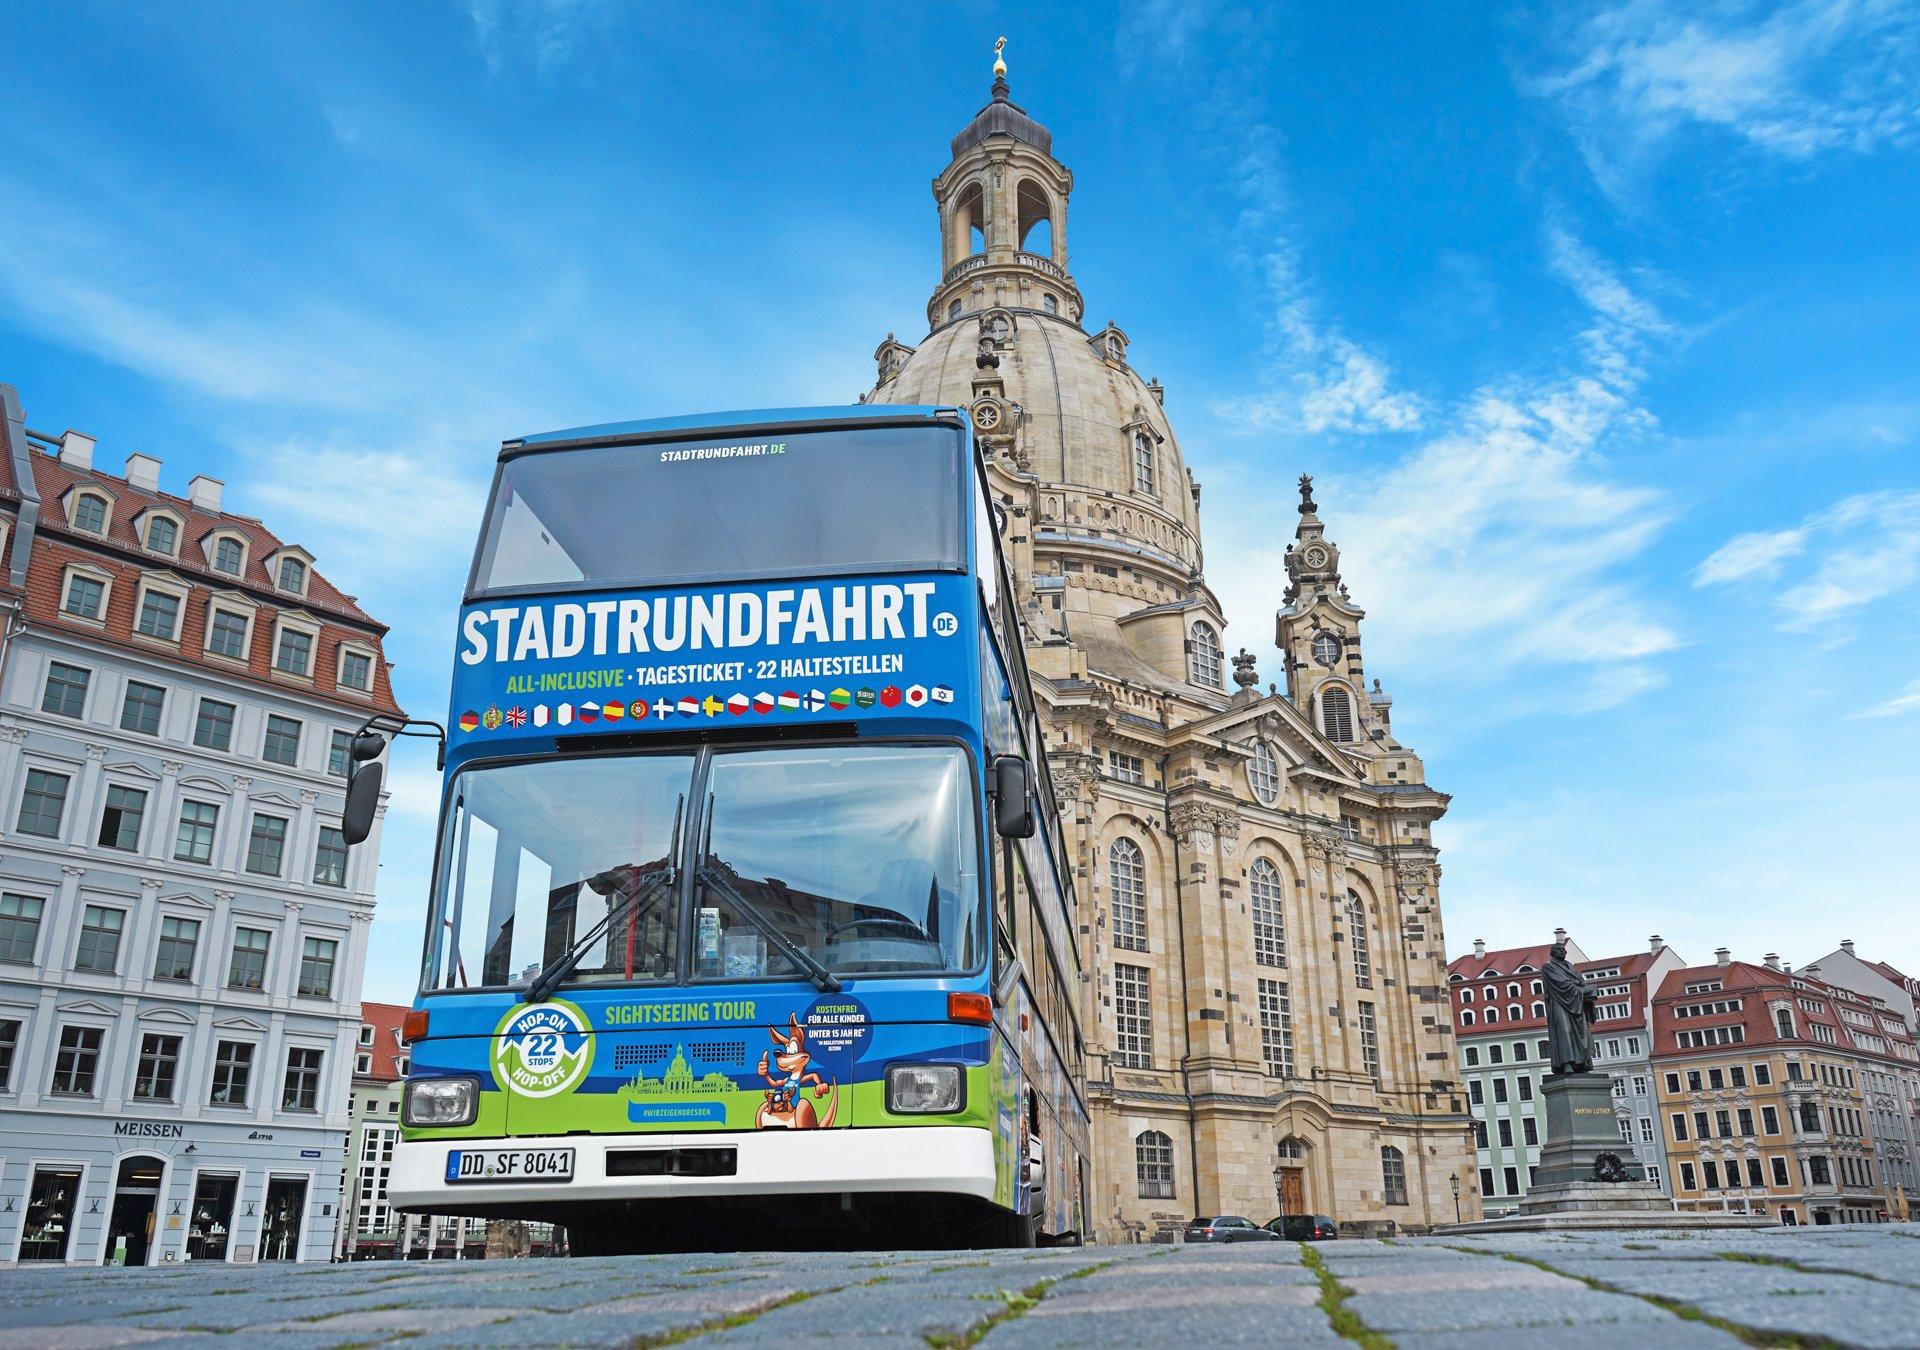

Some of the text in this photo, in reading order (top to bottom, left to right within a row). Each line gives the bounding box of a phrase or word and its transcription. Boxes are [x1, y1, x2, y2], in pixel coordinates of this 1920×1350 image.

[660, 443, 786, 462] STADTRUNDFAHRT.DE
[460, 582, 955, 665] STADTRUNDFAHRT DE
[506, 653, 904, 694] ALL-INCLUSIVE TAGESTICKET 22 HALTESTELLEN
[605, 1001, 756, 1025] SIGHTSEEING TOUR
[808, 1014, 865, 1024] FÜR ALLE KINDER
[816, 1005, 857, 1014] KOSTENFREI
[517, 1012, 568, 1033] HOP-ON
[809, 1029, 831, 1038] UNTER
[832, 1029, 840, 1038] 15
[528, 1034, 557, 1057] 22
[528, 1057, 554, 1067] STOPS
[512, 1066, 567, 1088] HOP-OFF
[114, 1121, 183, 1138] MEISSEN
[461, 1154, 484, 1175] DD
[496, 1153, 520, 1174] SF
[524, 1152, 569, 1174] 8041
